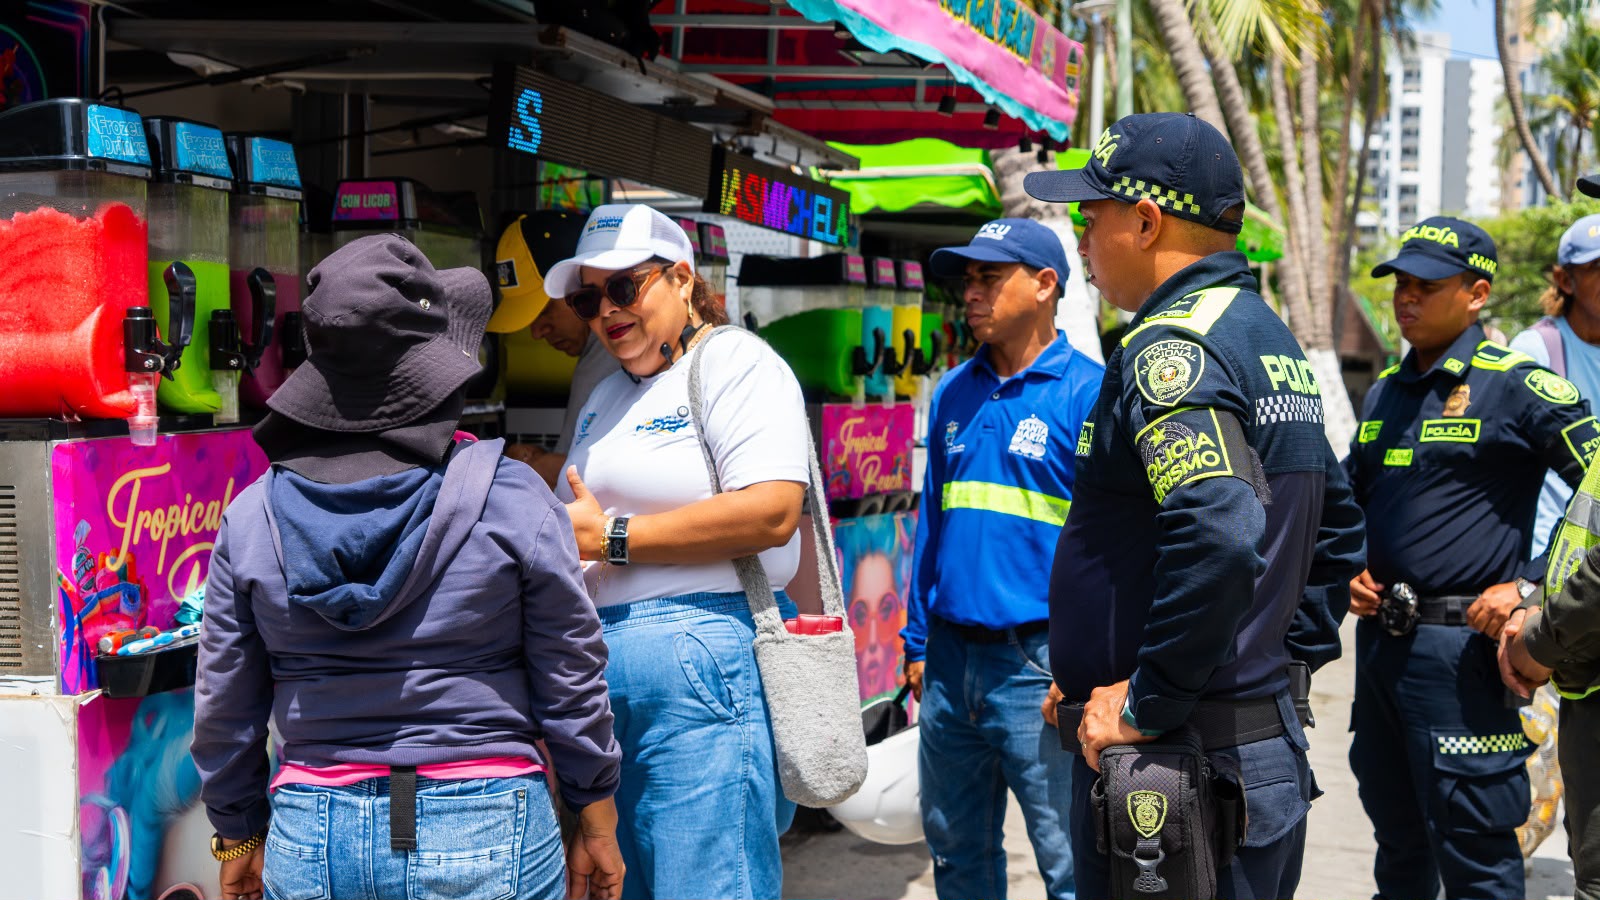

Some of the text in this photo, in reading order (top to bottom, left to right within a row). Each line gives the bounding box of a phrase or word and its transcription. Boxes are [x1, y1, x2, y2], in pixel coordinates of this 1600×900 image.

[95, 115, 144, 136] Frozen
[508, 89, 543, 154] S
[101, 135, 148, 158] Drinks
[182, 132, 226, 151] Frozen
[188, 149, 228, 169] Drinks
[341, 194, 391, 208] CON LICOR
[1140, 350, 1197, 375] NACIONAL
[1427, 424, 1473, 438] POLICÍA
[1147, 432, 1217, 484] OLICIA
[1154, 450, 1220, 505] URISMO
[106, 462, 234, 576] Tropical
